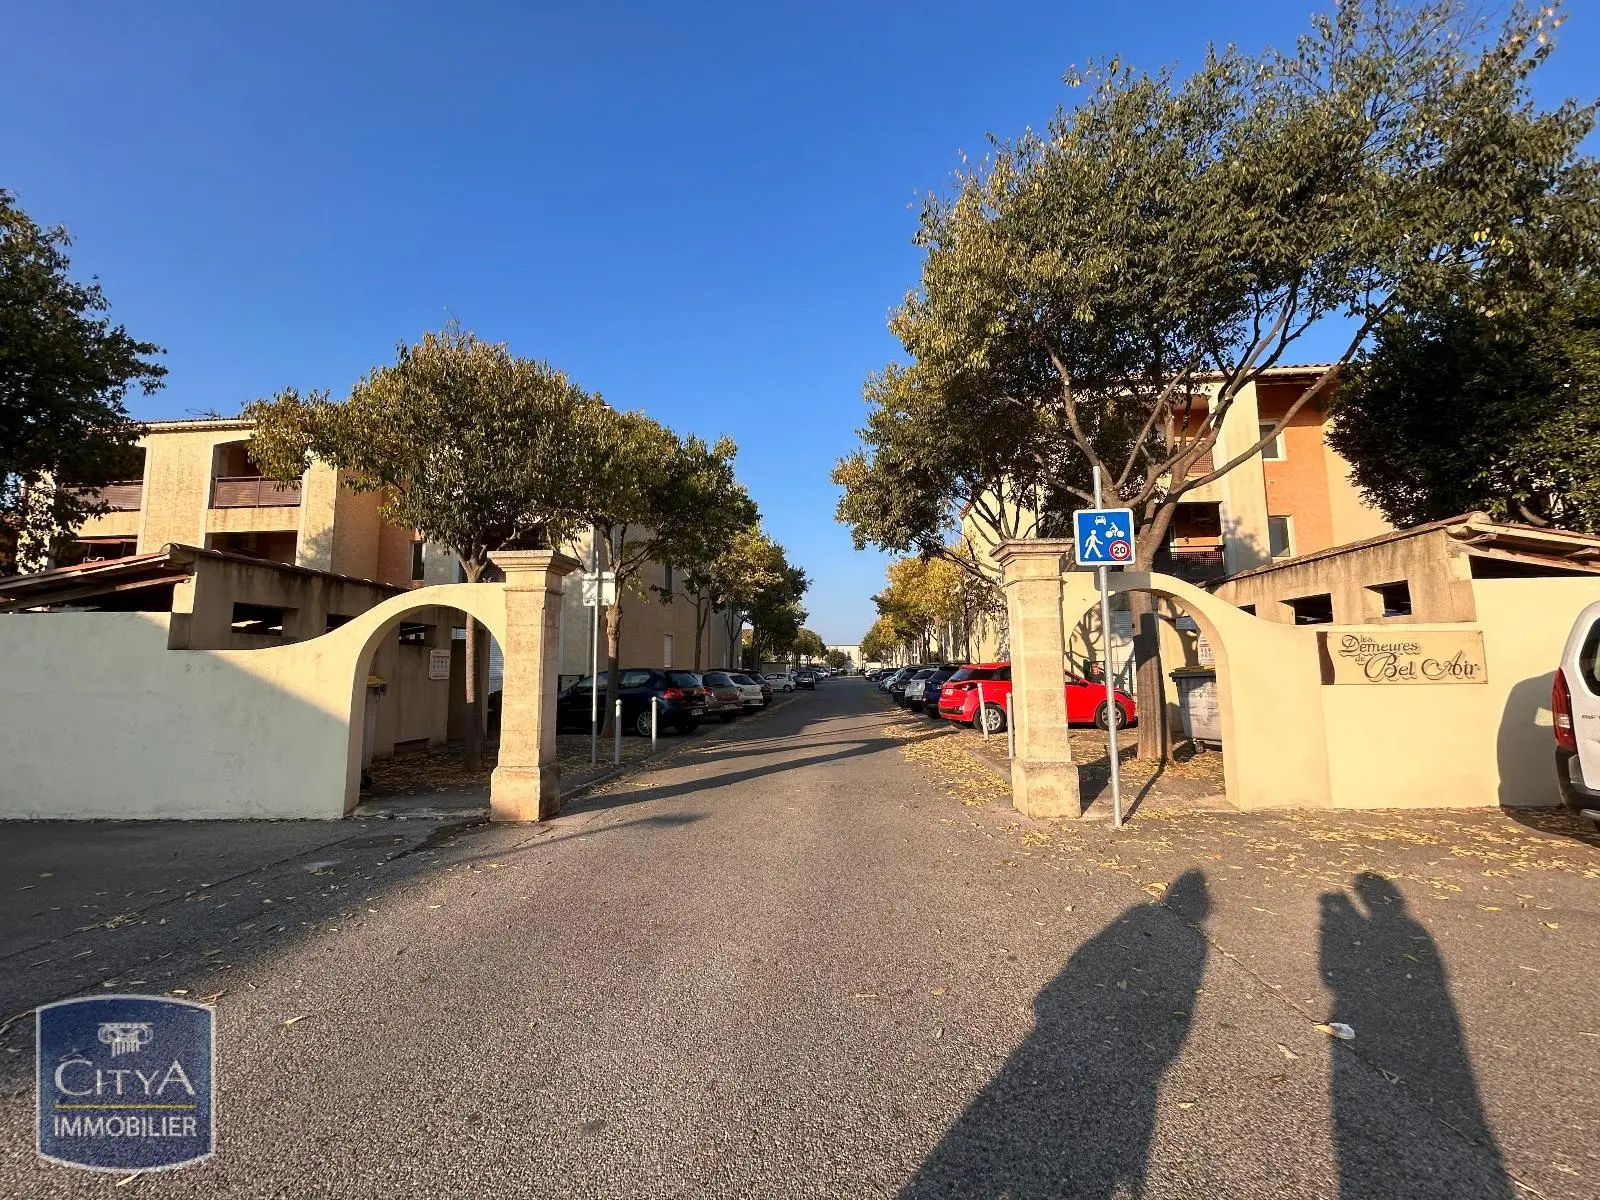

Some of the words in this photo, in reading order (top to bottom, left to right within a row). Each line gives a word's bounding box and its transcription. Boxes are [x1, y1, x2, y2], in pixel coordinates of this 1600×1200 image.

[1338, 634, 1420, 655] Demeures
[1360, 634, 1374, 643] les
[1355, 654, 1367, 663] de
[1364, 652, 1416, 679] Bel
[1421, 650, 1479, 680] Air
